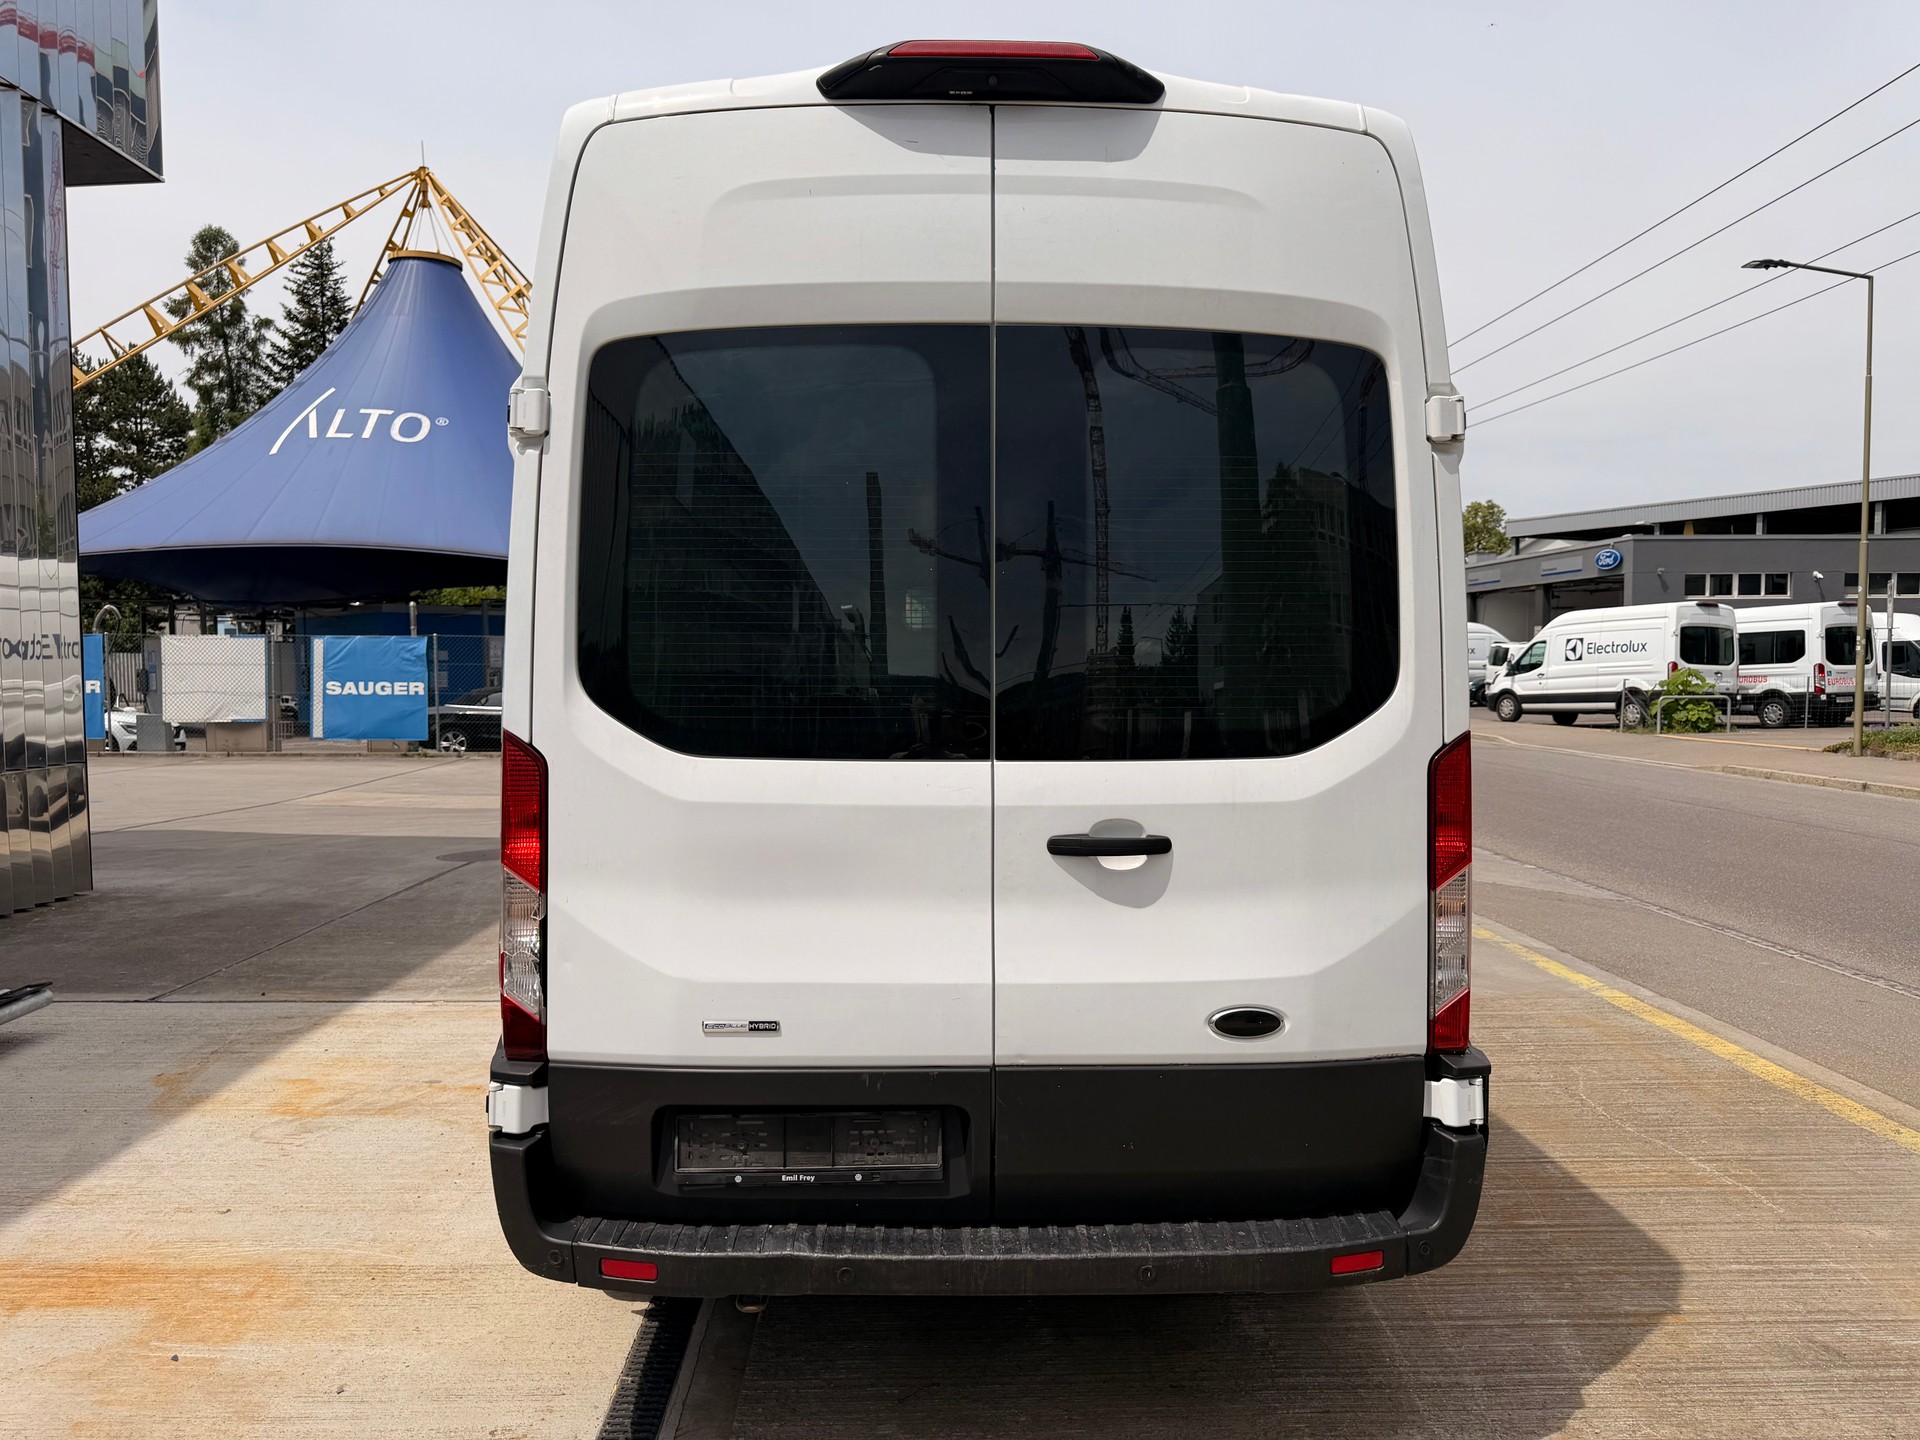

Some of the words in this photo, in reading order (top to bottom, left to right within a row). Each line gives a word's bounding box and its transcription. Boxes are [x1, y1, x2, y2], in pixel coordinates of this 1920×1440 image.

[1599, 552, 1615, 566] Ford
[1586, 640, 1648, 654] Electrolux
[1738, 676, 1768, 684] UROBUS
[1828, 678, 1855, 686] EUROBUS
[326, 681, 425, 696] SAUGER
